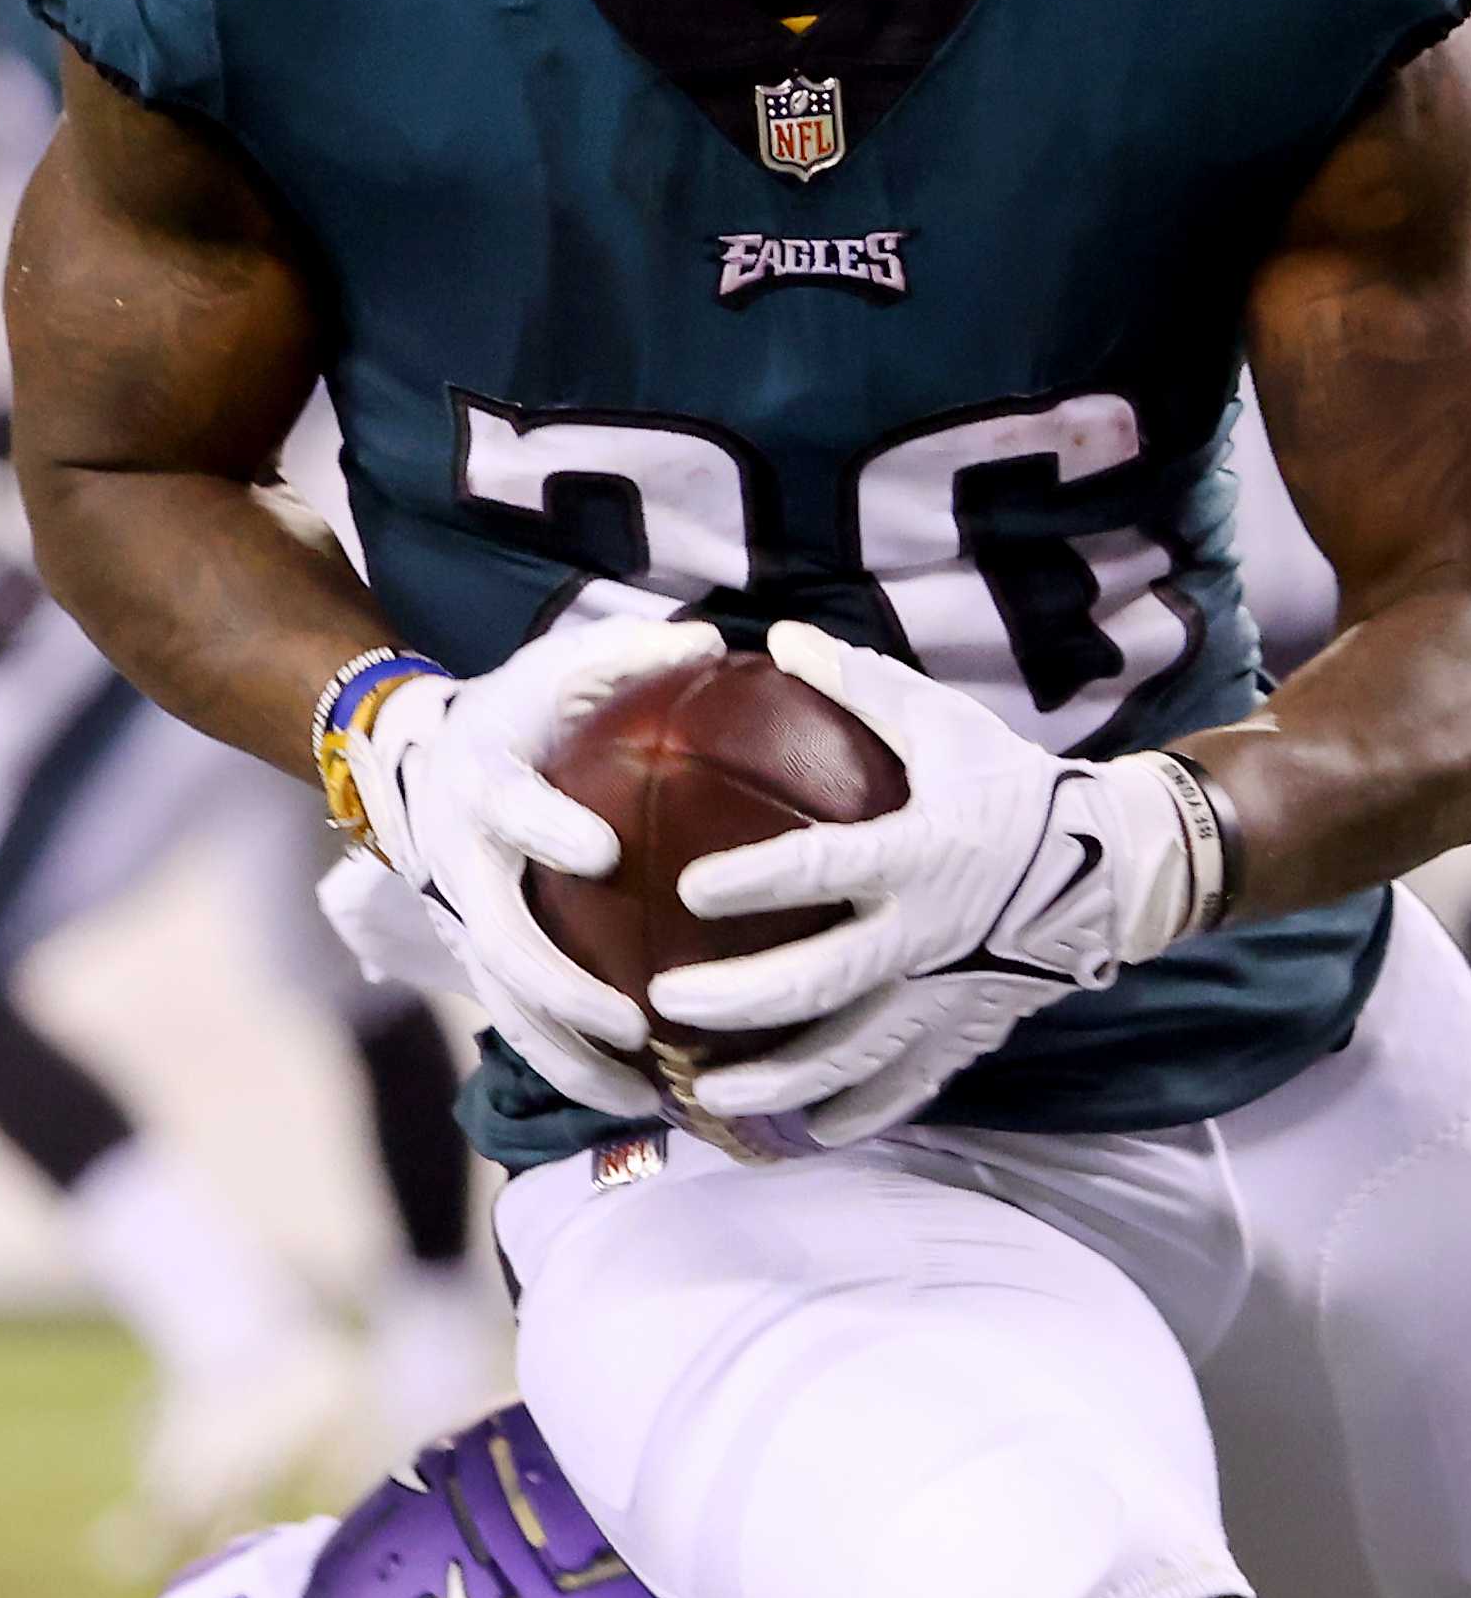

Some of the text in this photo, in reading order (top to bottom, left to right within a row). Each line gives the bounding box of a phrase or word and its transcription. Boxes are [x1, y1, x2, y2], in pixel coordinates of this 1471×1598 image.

[774, 121, 833, 162] NFL
[716, 230, 908, 297] EAGLES
[452, 384, 1206, 761] 26
